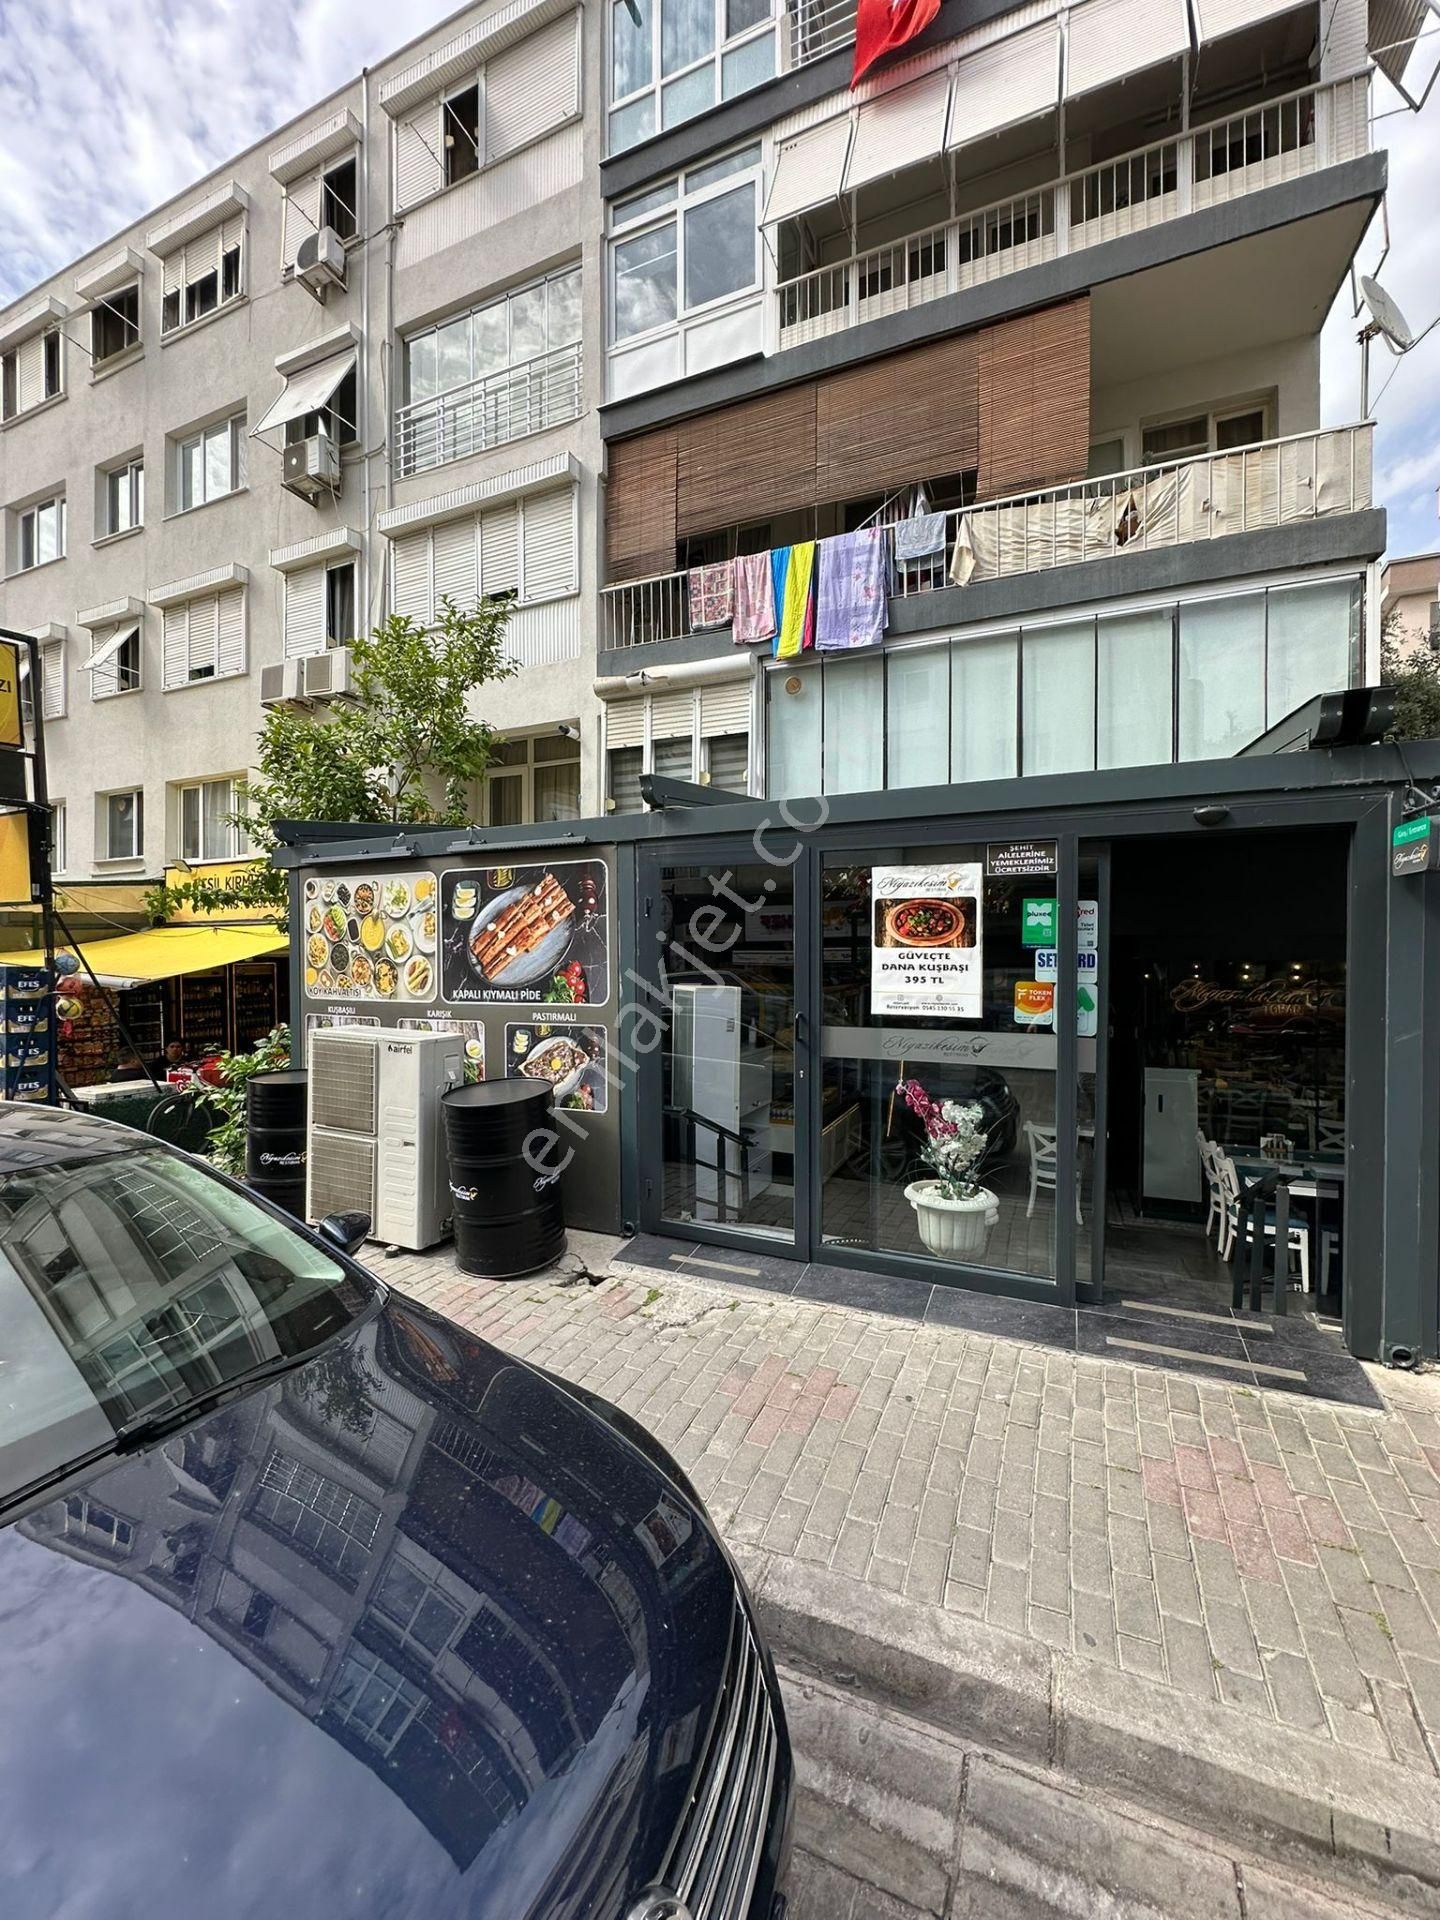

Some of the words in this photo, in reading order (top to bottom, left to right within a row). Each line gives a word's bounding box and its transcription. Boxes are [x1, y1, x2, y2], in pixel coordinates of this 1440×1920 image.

[1009, 844, 1034, 852] ŞEHİT
[998, 850, 1047, 859] AİLELERİNE
[990, 857, 1055, 866] YEMEKLERİMİZ
[995, 865, 1050, 873] ÜCRETSİZDİR
[898, 950, 951, 961] GÜVEÇTE
[881, 963, 915, 971] DANA
[919, 963, 969, 973] KUŞBAŞI
[904, 976, 927, 984] 395
[930, 976, 945, 984] TL
[452, 989, 481, 999] KAPALI
[483, 990, 519, 1000] KIYMALI
[520, 988, 541, 1000] PİDE
[327, 1006, 356, 1015] KUŞBAŞILI
[427, 1010, 452, 1019] KARIŞIK
[532, 1012, 577, 1022] PASTIRMALI
[18, 1048, 39, 1056] EES
[393, 1045, 413, 1055] airfel
[18, 1081, 39, 1090] EFES
